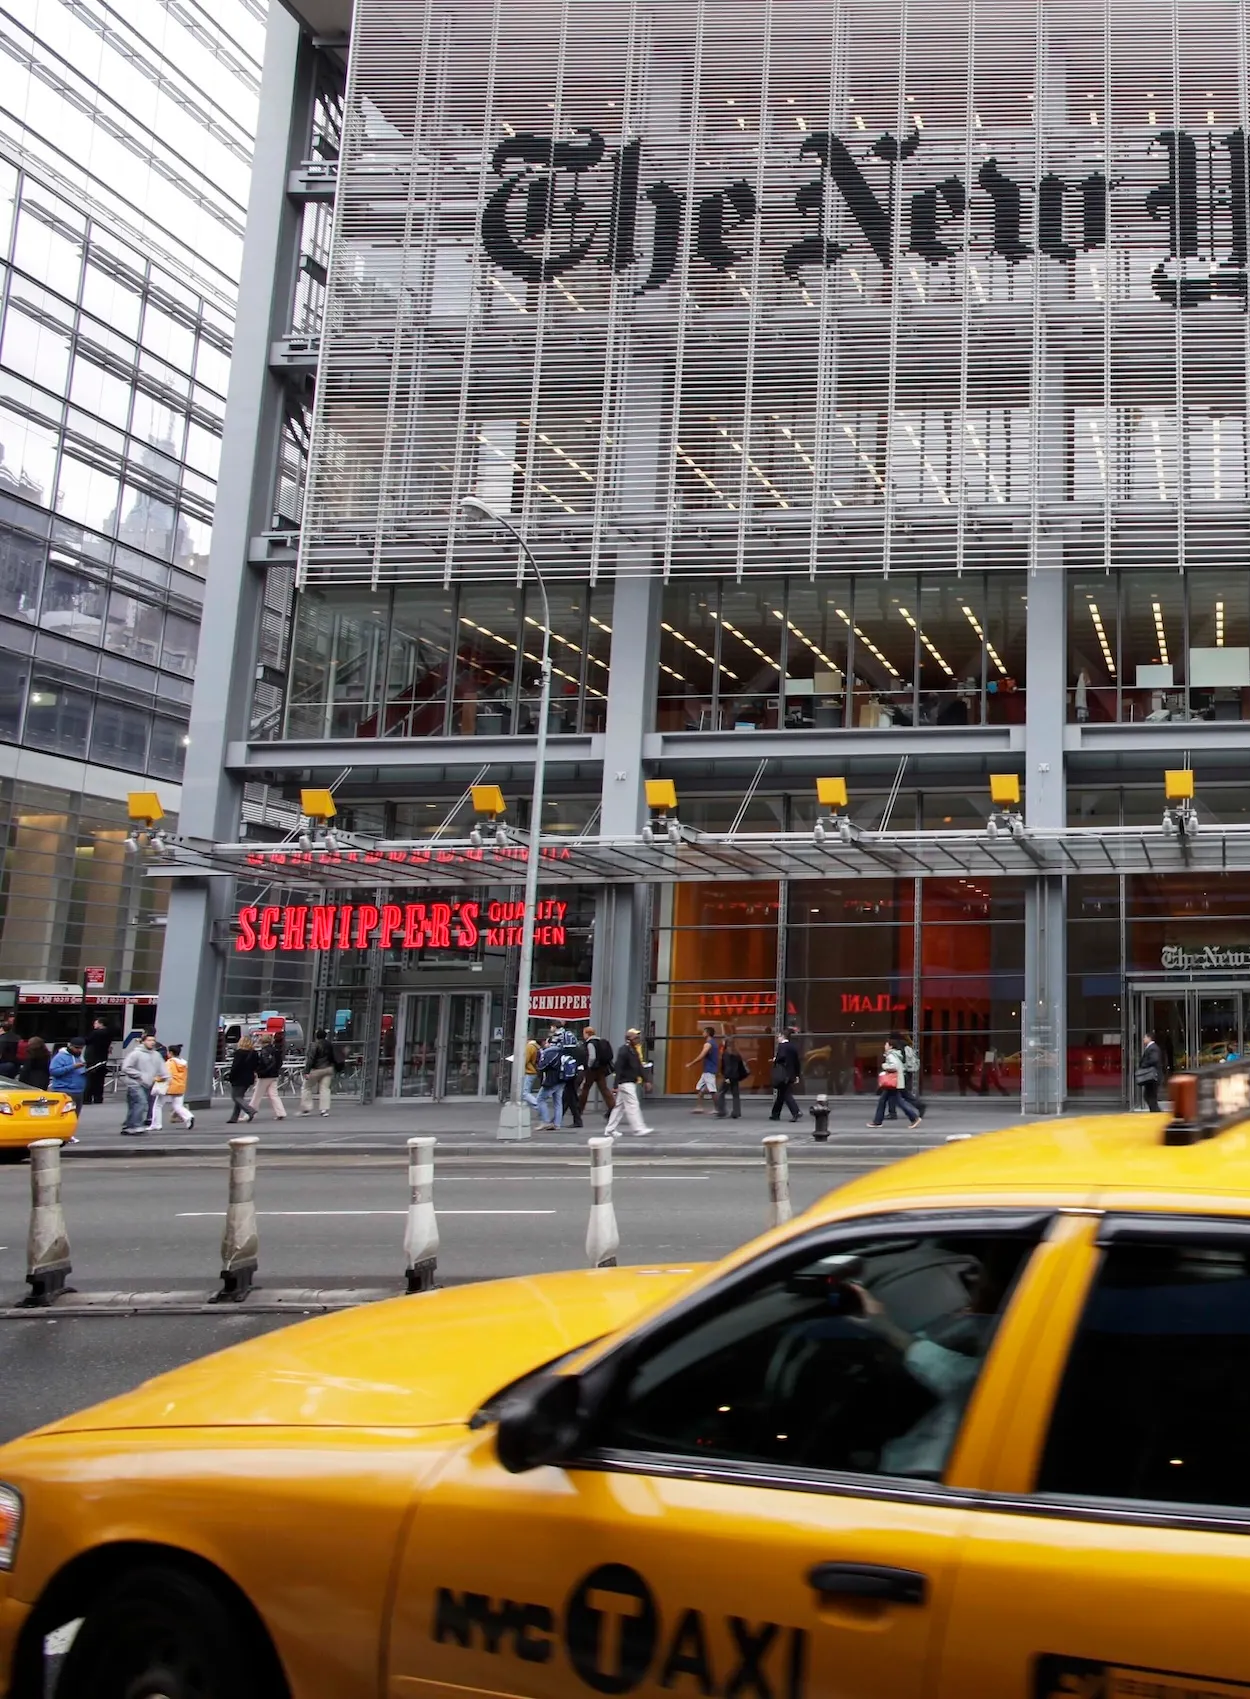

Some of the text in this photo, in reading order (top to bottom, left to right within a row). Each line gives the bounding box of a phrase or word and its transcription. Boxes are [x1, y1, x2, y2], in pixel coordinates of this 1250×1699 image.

[480, 126, 758, 296] The
[783, 128, 1116, 280] New
[235, 903, 479, 951] SCHNIPPER'S
[488, 901, 568, 921] QUAITY
[1161, 945, 1197, 970] The
[1200, 945, 1244, 969] New
[432, 1586, 556, 1664] NYC
